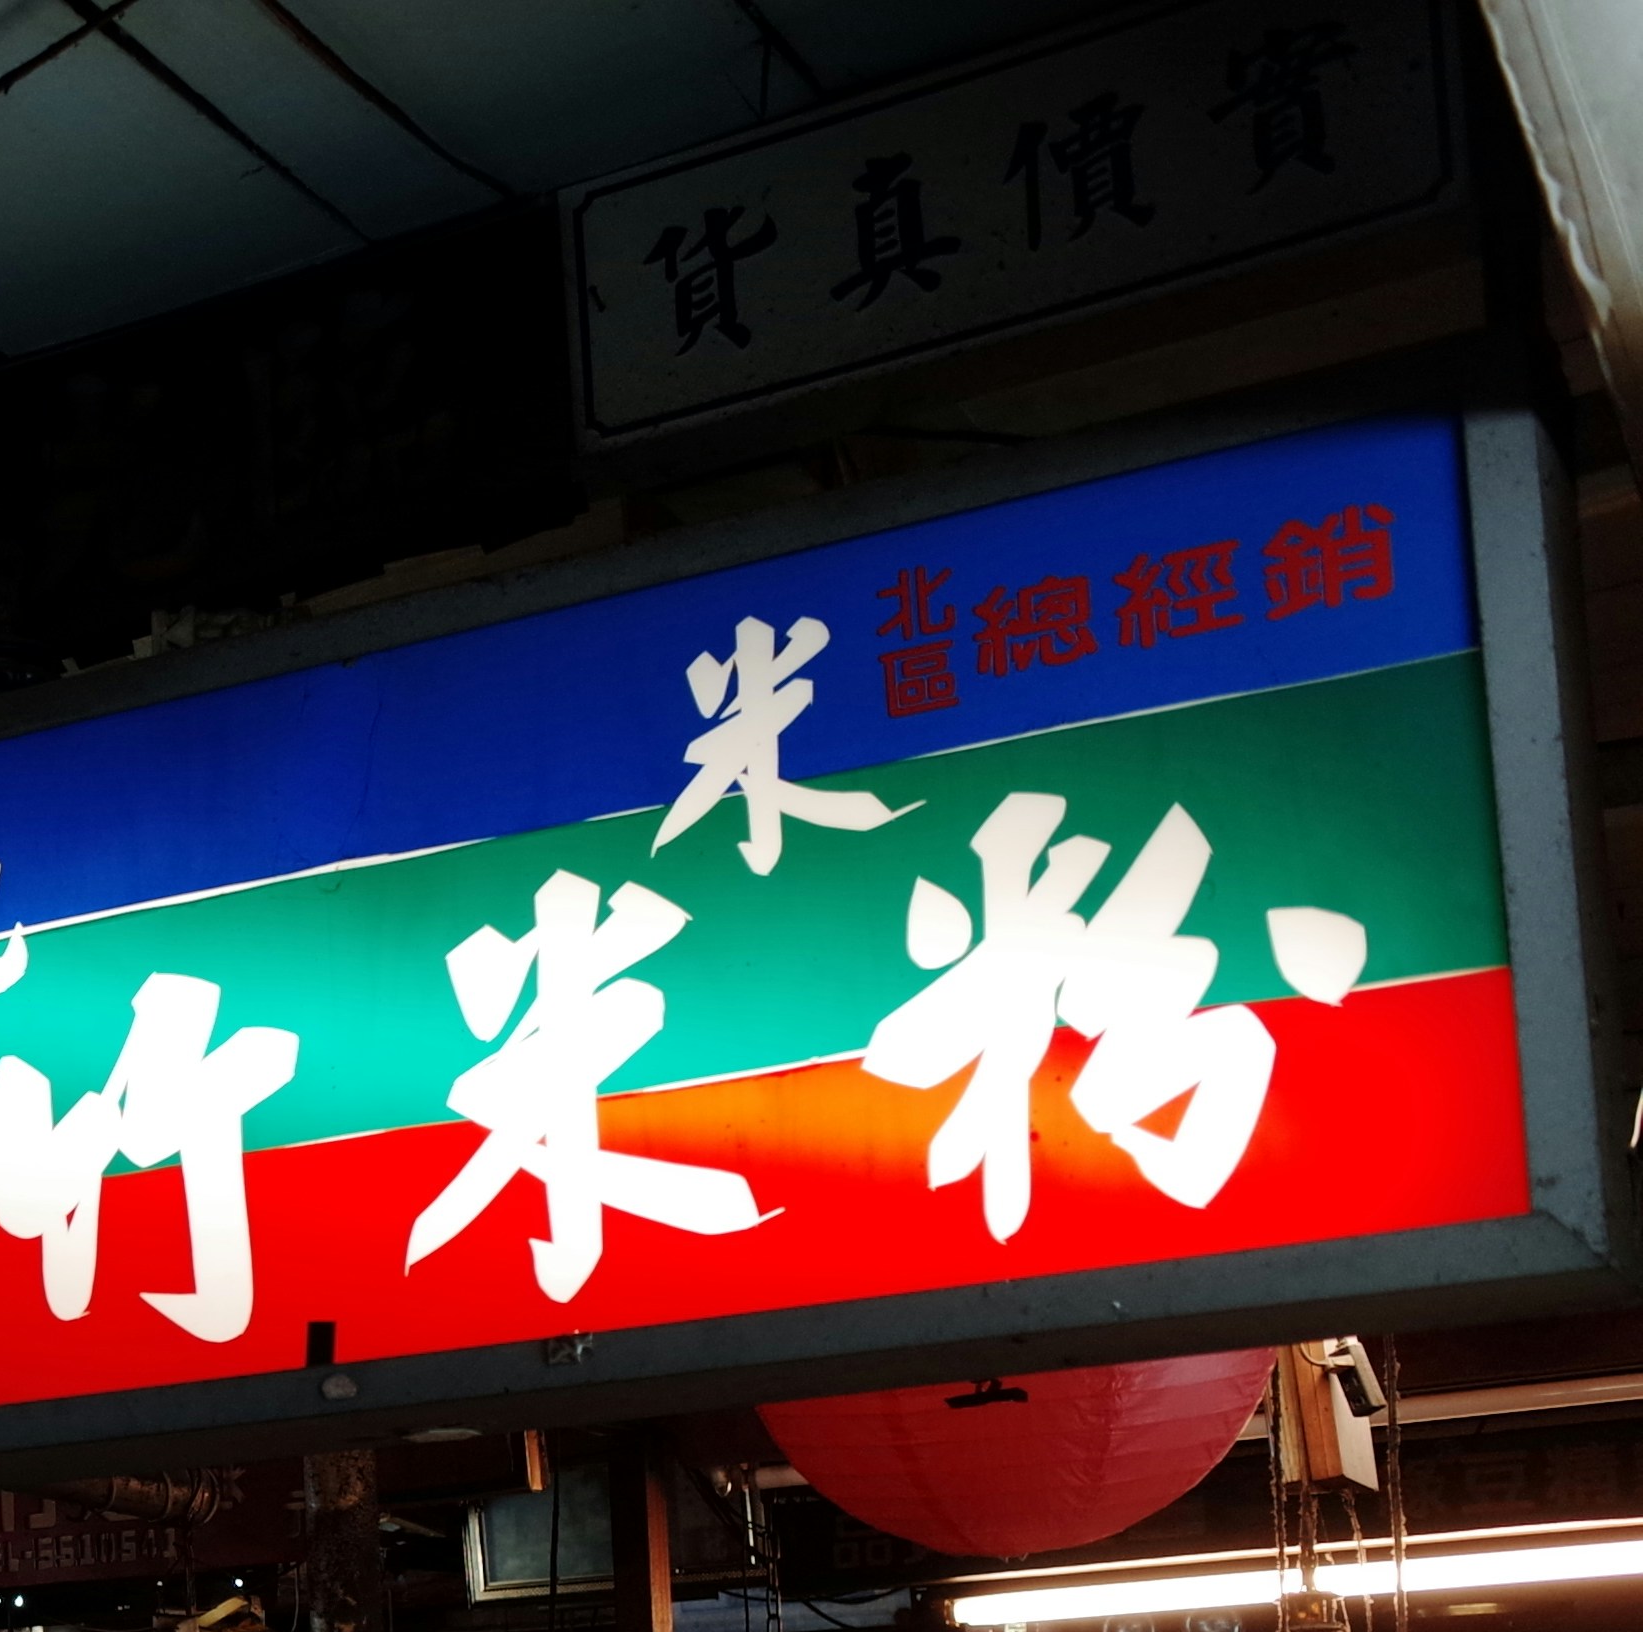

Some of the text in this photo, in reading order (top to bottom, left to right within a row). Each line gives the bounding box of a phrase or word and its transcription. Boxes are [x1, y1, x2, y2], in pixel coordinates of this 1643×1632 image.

[642, 20, 1359, 358] 貨真價實
[969, 505, 1399, 680] 總經銷
[651, 613, 929, 877] 米
